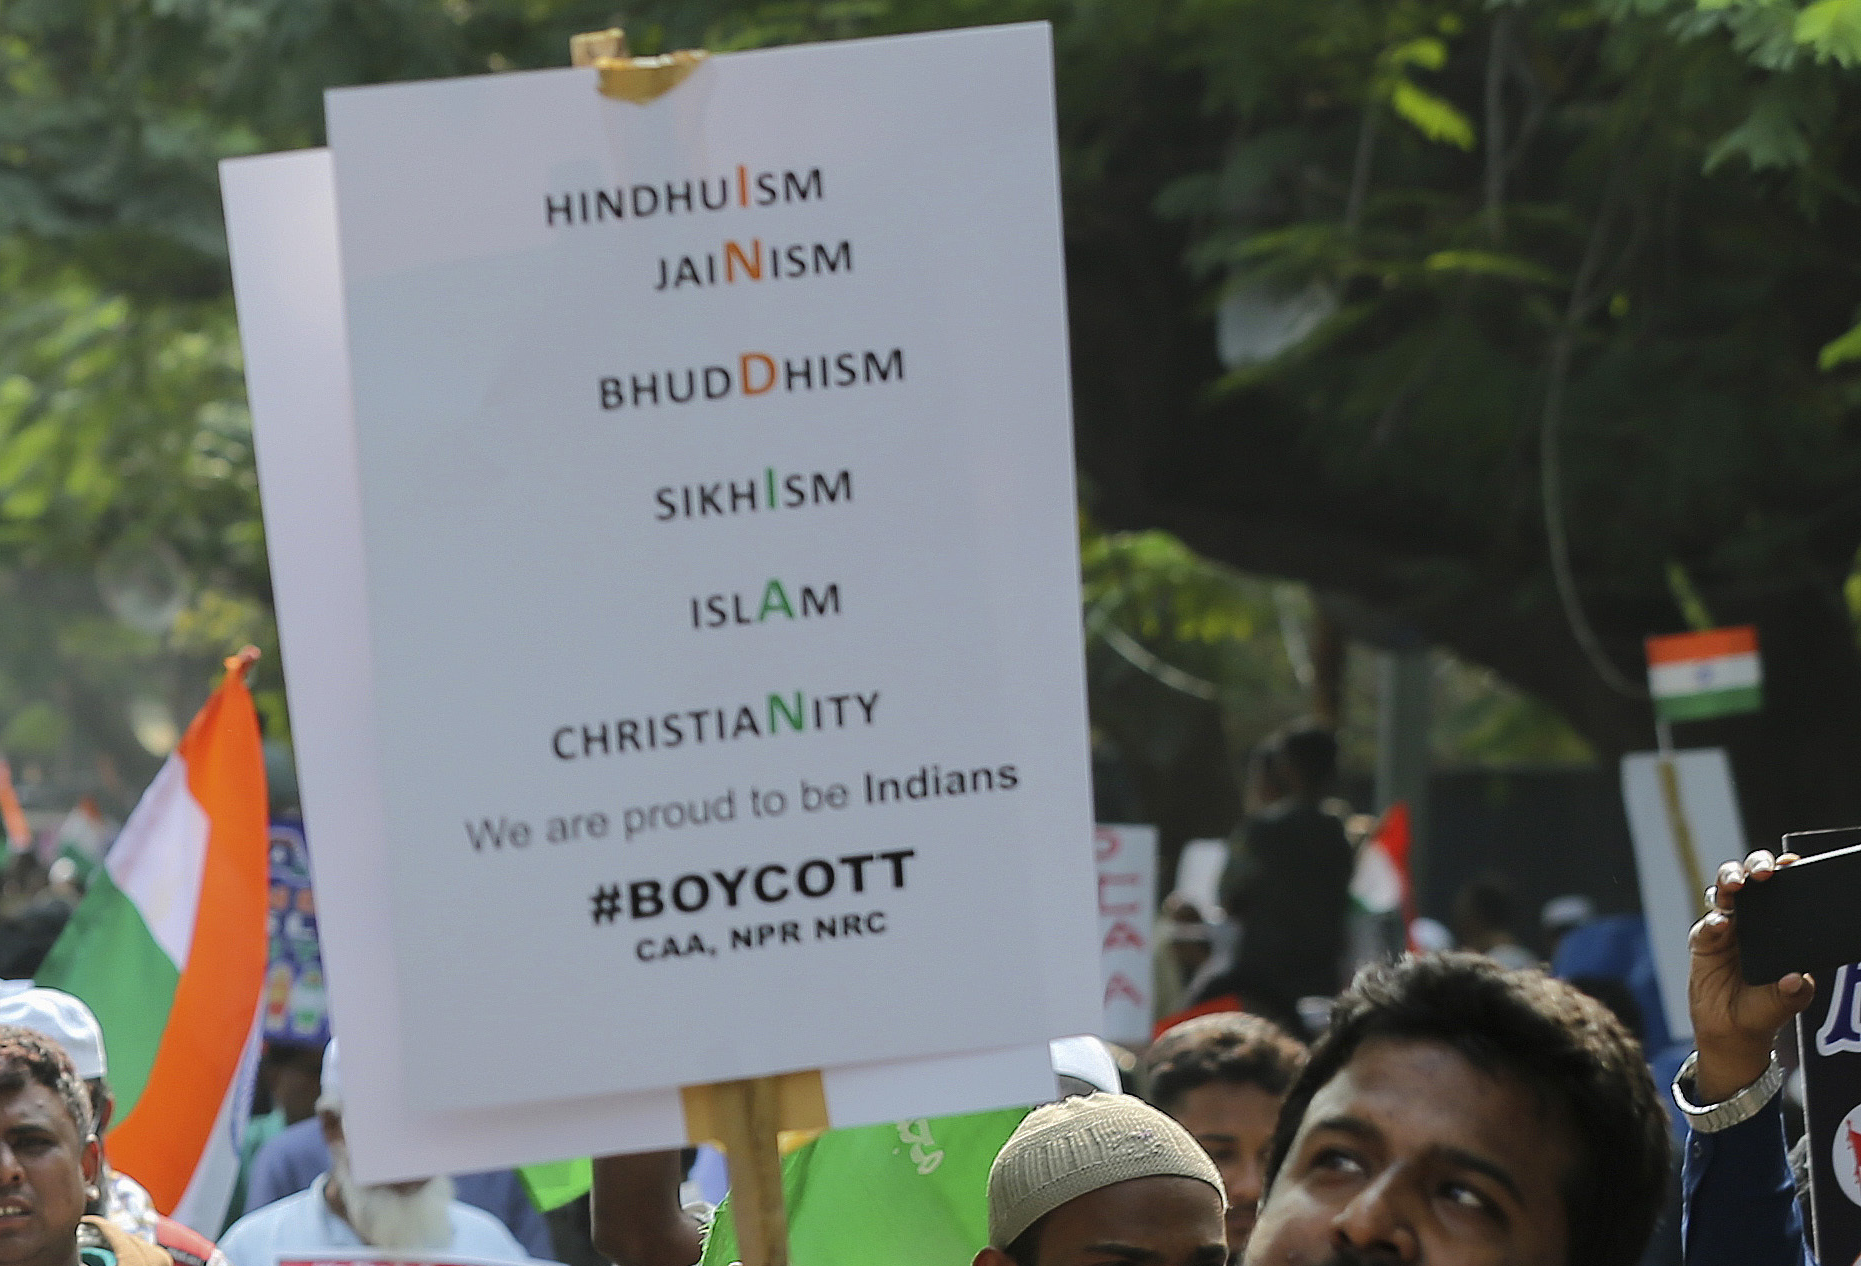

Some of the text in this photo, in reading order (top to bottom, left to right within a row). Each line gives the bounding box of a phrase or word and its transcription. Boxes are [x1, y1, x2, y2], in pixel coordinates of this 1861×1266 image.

[545, 166, 823, 227] HINDHUISM
[655, 239, 853, 290] JAINISM
[599, 348, 904, 410] BHUDDHISM
[655, 467, 852, 521] SIKHISM
[691, 579, 840, 629] ISLAM
[552, 691, 880, 760] CHRISTIANITY
[465, 764, 1019, 852] We are proud to be Indians
[590, 849, 915, 926] #BOYCOTT
[636, 911, 886, 962] CAA, NPR NRC
